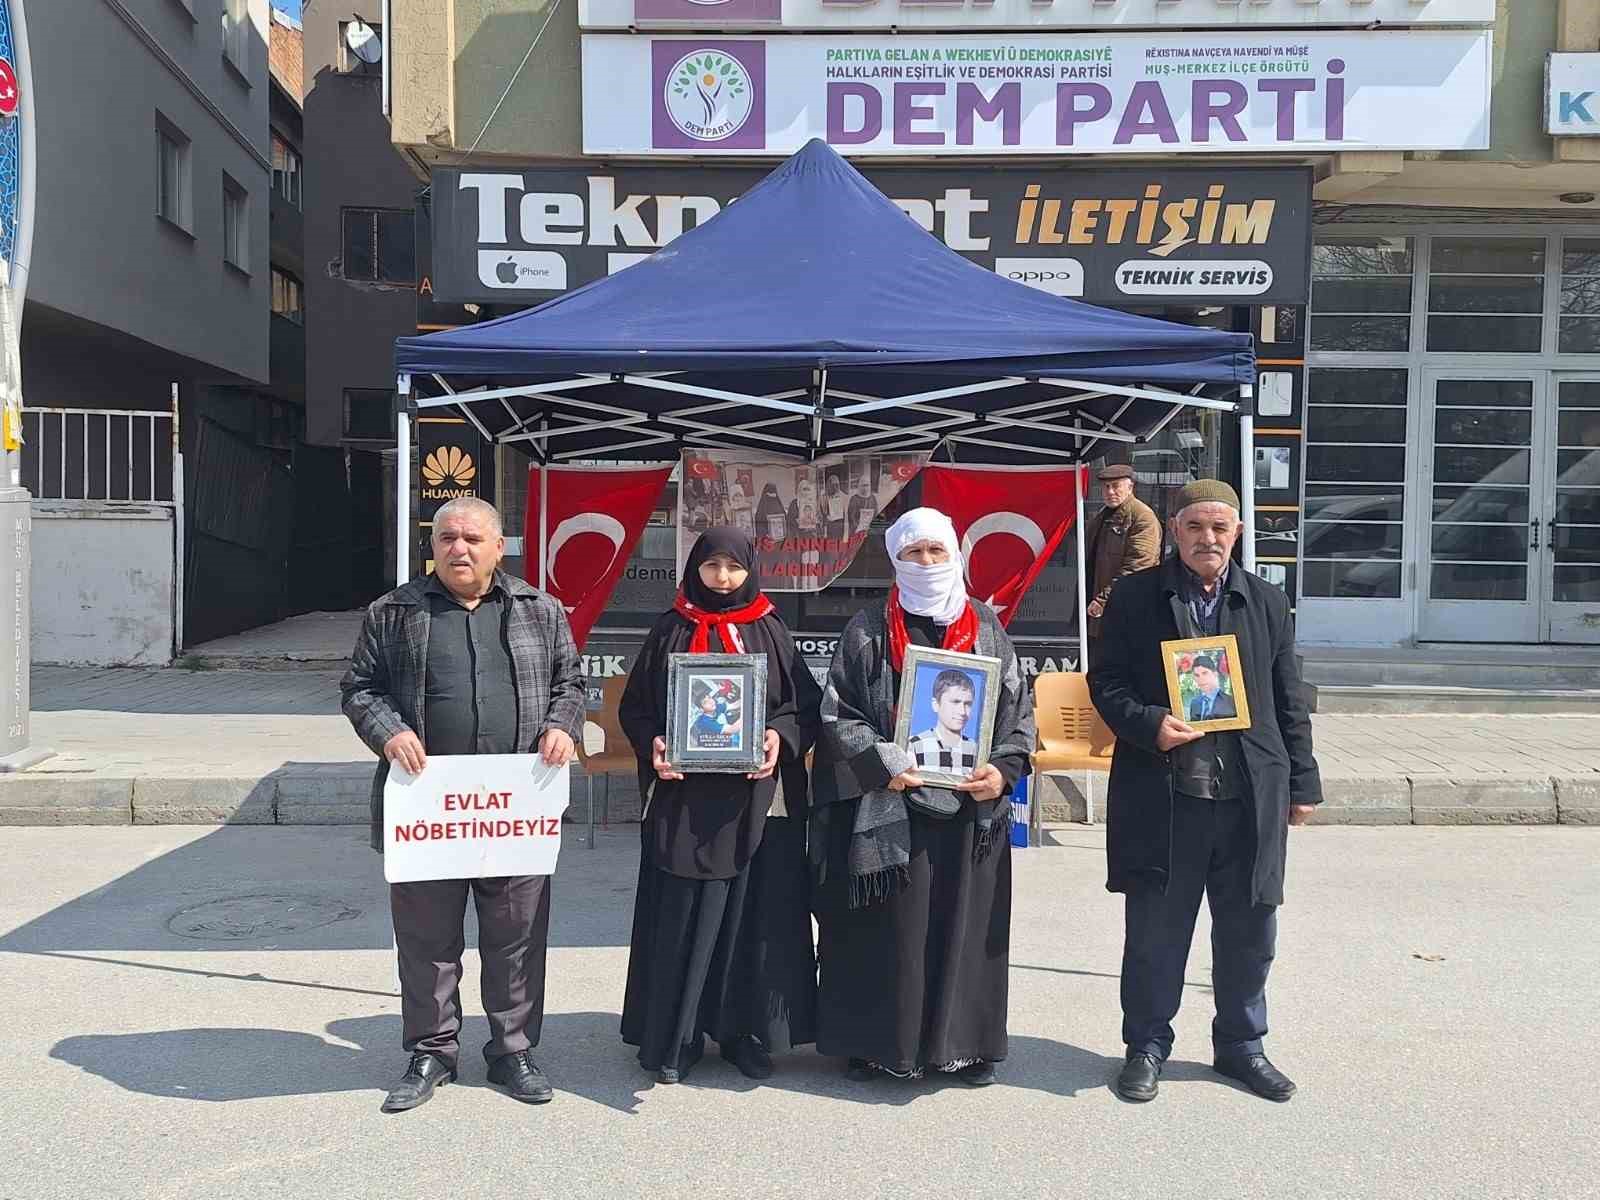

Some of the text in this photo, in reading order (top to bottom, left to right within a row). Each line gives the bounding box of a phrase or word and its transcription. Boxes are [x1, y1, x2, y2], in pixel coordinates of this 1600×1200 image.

[885, 48, 929, 61] GELAN
[932, 48, 941, 60] A
[1192, 47, 1232, 58] NAVÇEYA
[1274, 47, 1284, 56] YA
[827, 64, 1112, 80] HALKLARIN EŞİTLİK VE DEMOKRASİ PARTİSİ
[1229, 60, 1257, 75] İLÇE
[1260, 59, 1309, 73] ÖRGÜTÜ
[827, 58, 1345, 145] DEM PARTİ
[684, 121, 704, 135] DEM
[1015, 184, 1277, 257] İLETİŞİM
[520, 267, 549, 277] iPhone
[1008, 270, 1070, 282] oppo
[1121, 268, 1268, 286] TEKNİK SERVİS
[444, 792, 513, 811] EVLAT
[395, 815, 560, 842] NÖBETİNDEYİZ
